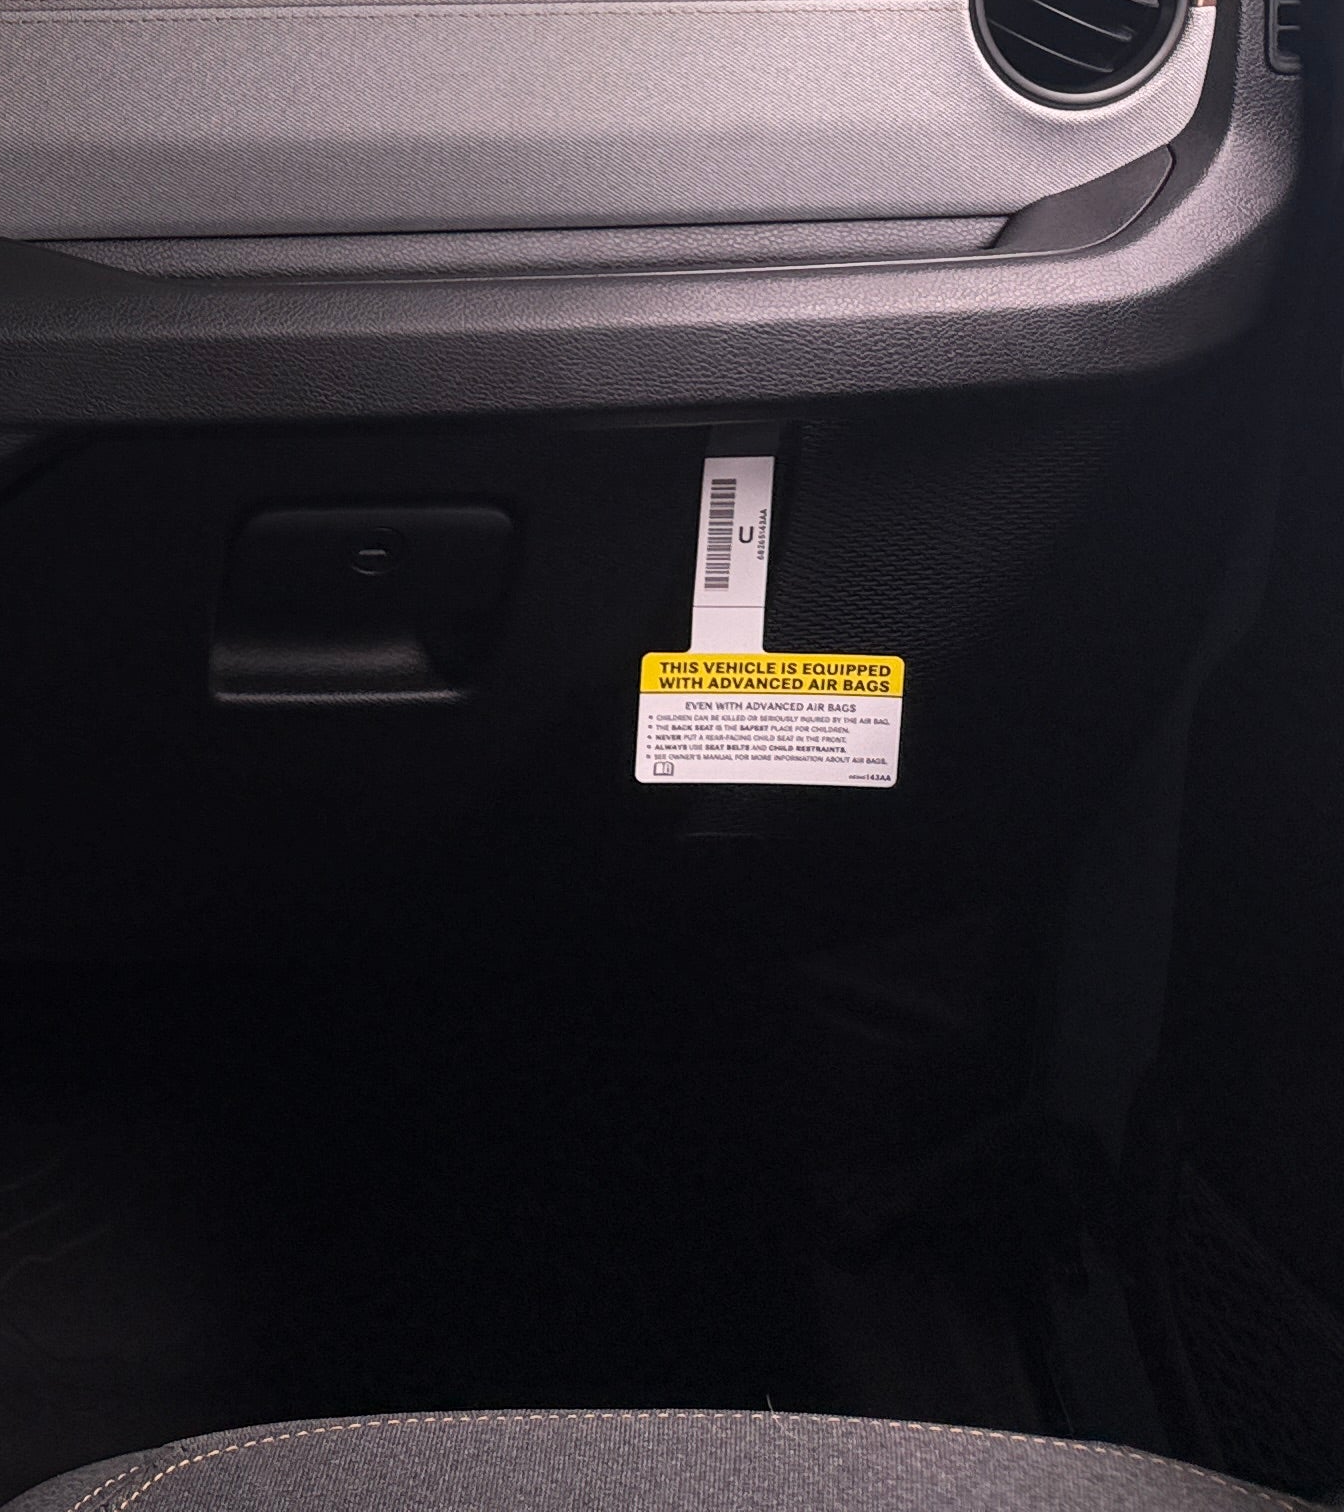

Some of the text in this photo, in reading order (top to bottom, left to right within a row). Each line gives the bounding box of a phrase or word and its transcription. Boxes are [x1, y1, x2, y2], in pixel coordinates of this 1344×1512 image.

[739, 526, 754, 544] U
[660, 662, 891, 677] THIS VEHICLE IS EQUIPPED
[659, 677, 890, 693] WITH ADVANCED AIR BAGS
[685, 701, 857, 713] EVEN WITH ADVANCED AIR BAGS
[726, 744, 750, 752] BELTS
